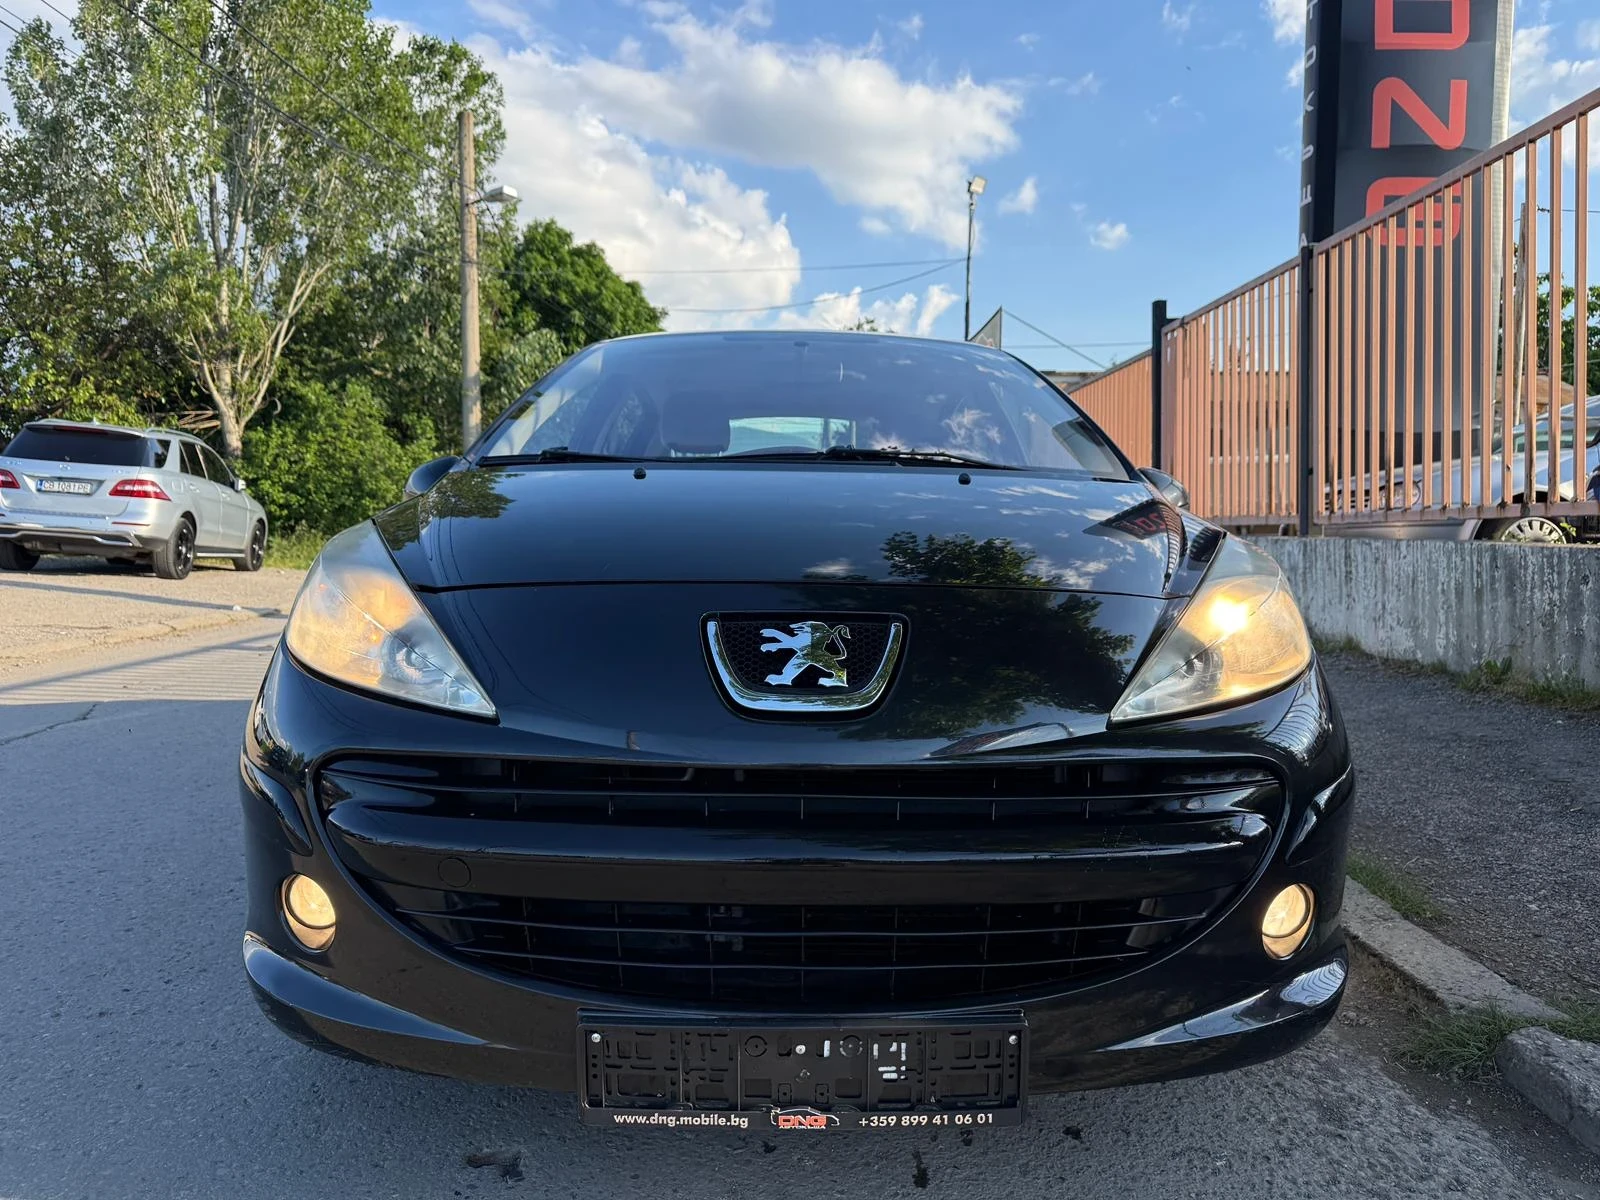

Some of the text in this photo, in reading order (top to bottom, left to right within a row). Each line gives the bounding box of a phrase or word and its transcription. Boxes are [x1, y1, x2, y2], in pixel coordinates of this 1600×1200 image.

[613, 1112, 749, 1128] www.dng.mobile.bg
[778, 1115, 827, 1126] DNG
[858, 1112, 994, 1127] +359 899 41 06 01
